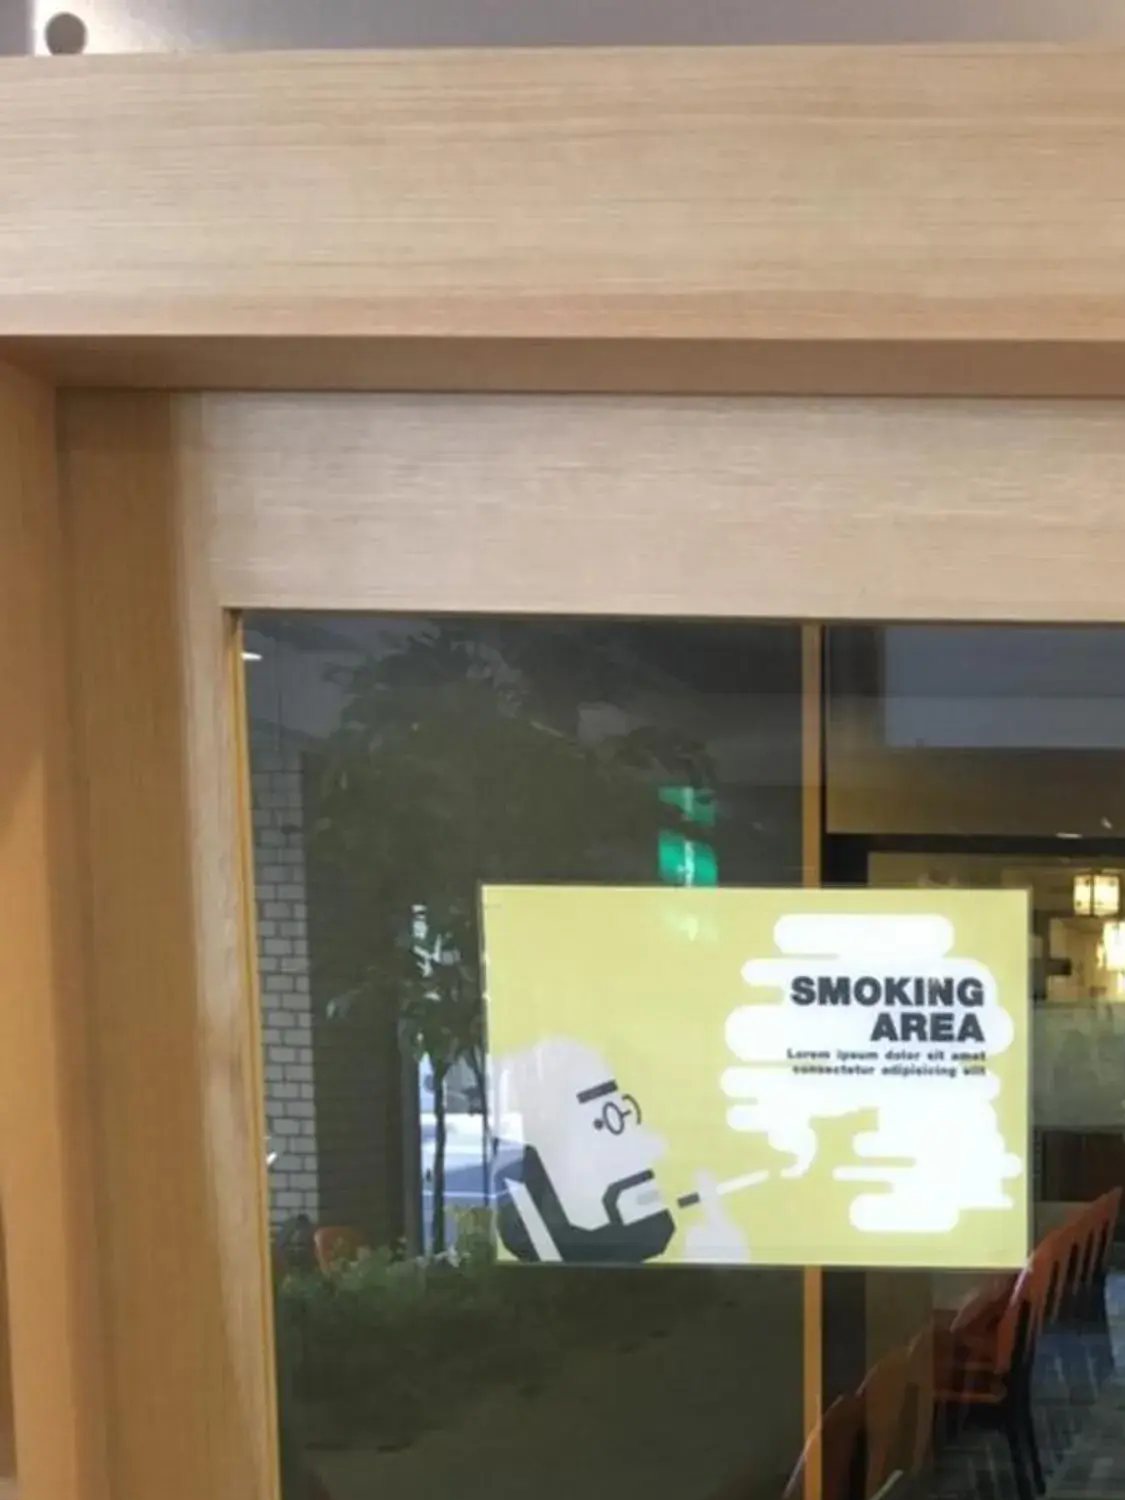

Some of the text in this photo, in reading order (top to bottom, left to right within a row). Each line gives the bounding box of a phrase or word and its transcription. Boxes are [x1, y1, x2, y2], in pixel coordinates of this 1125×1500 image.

[790, 976, 985, 1007] SMOKING
[869, 1012, 986, 1042] AREA
[787, 1049, 986, 1062] Lorem ipsum dolor sit amet
